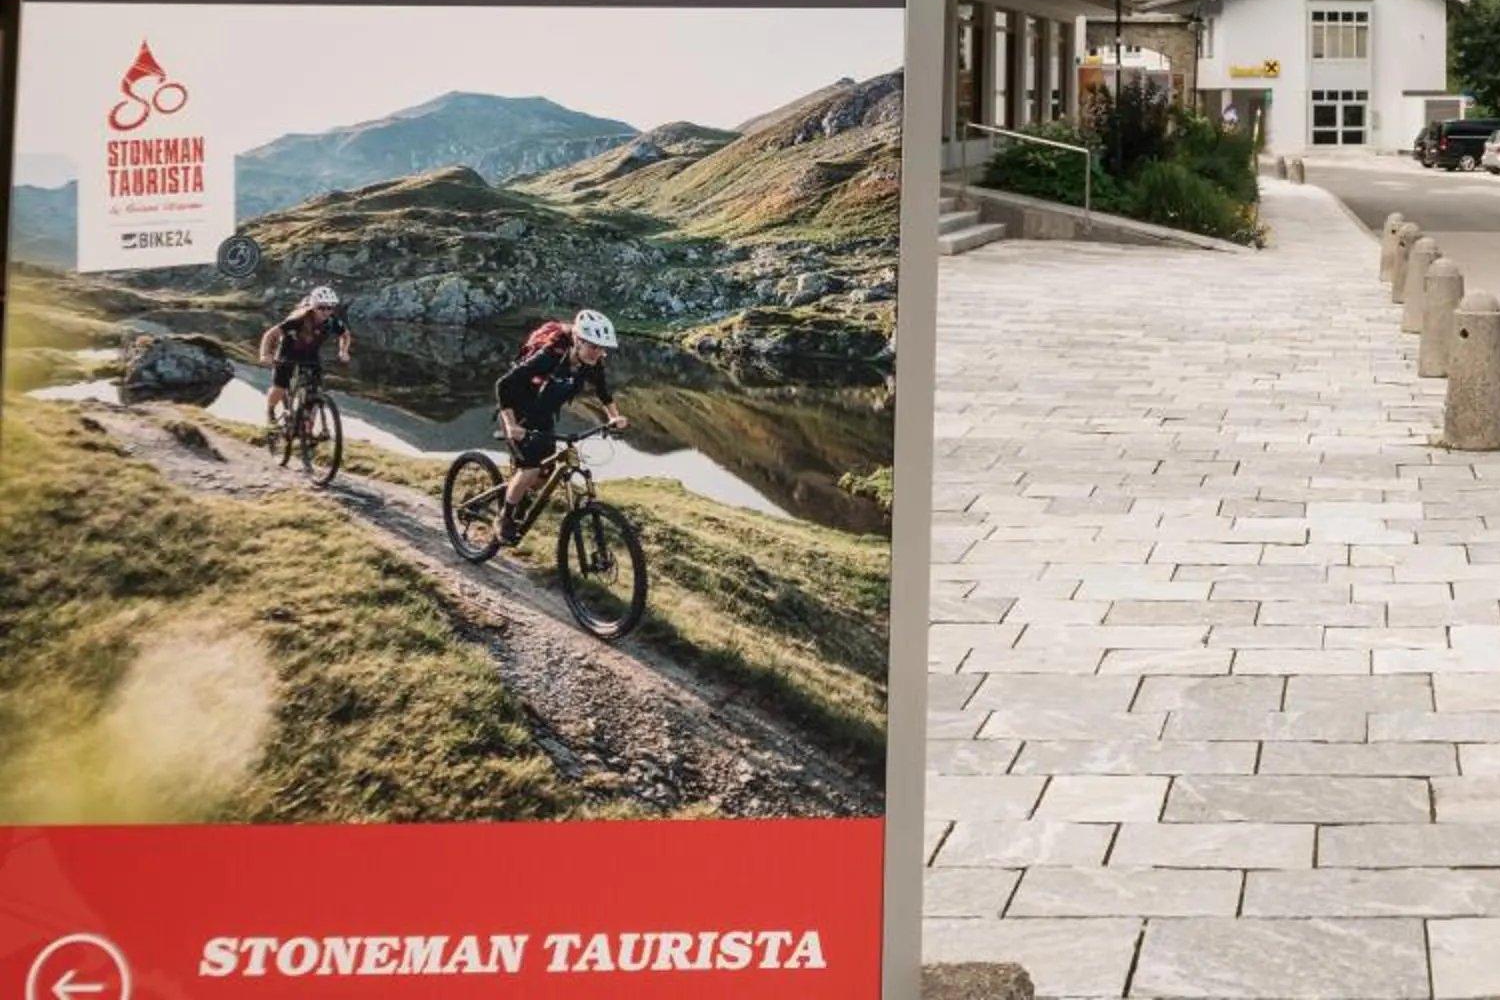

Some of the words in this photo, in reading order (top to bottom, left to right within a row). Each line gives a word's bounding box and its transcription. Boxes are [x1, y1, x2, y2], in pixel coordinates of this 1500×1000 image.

[107, 137, 205, 167] STONEMAN
[107, 166, 205, 197] TAURISTA
[138, 231, 193, 249] BIKE24
[199, 934, 529, 977] STONEMAN
[545, 931, 827, 971] TAURISTA
